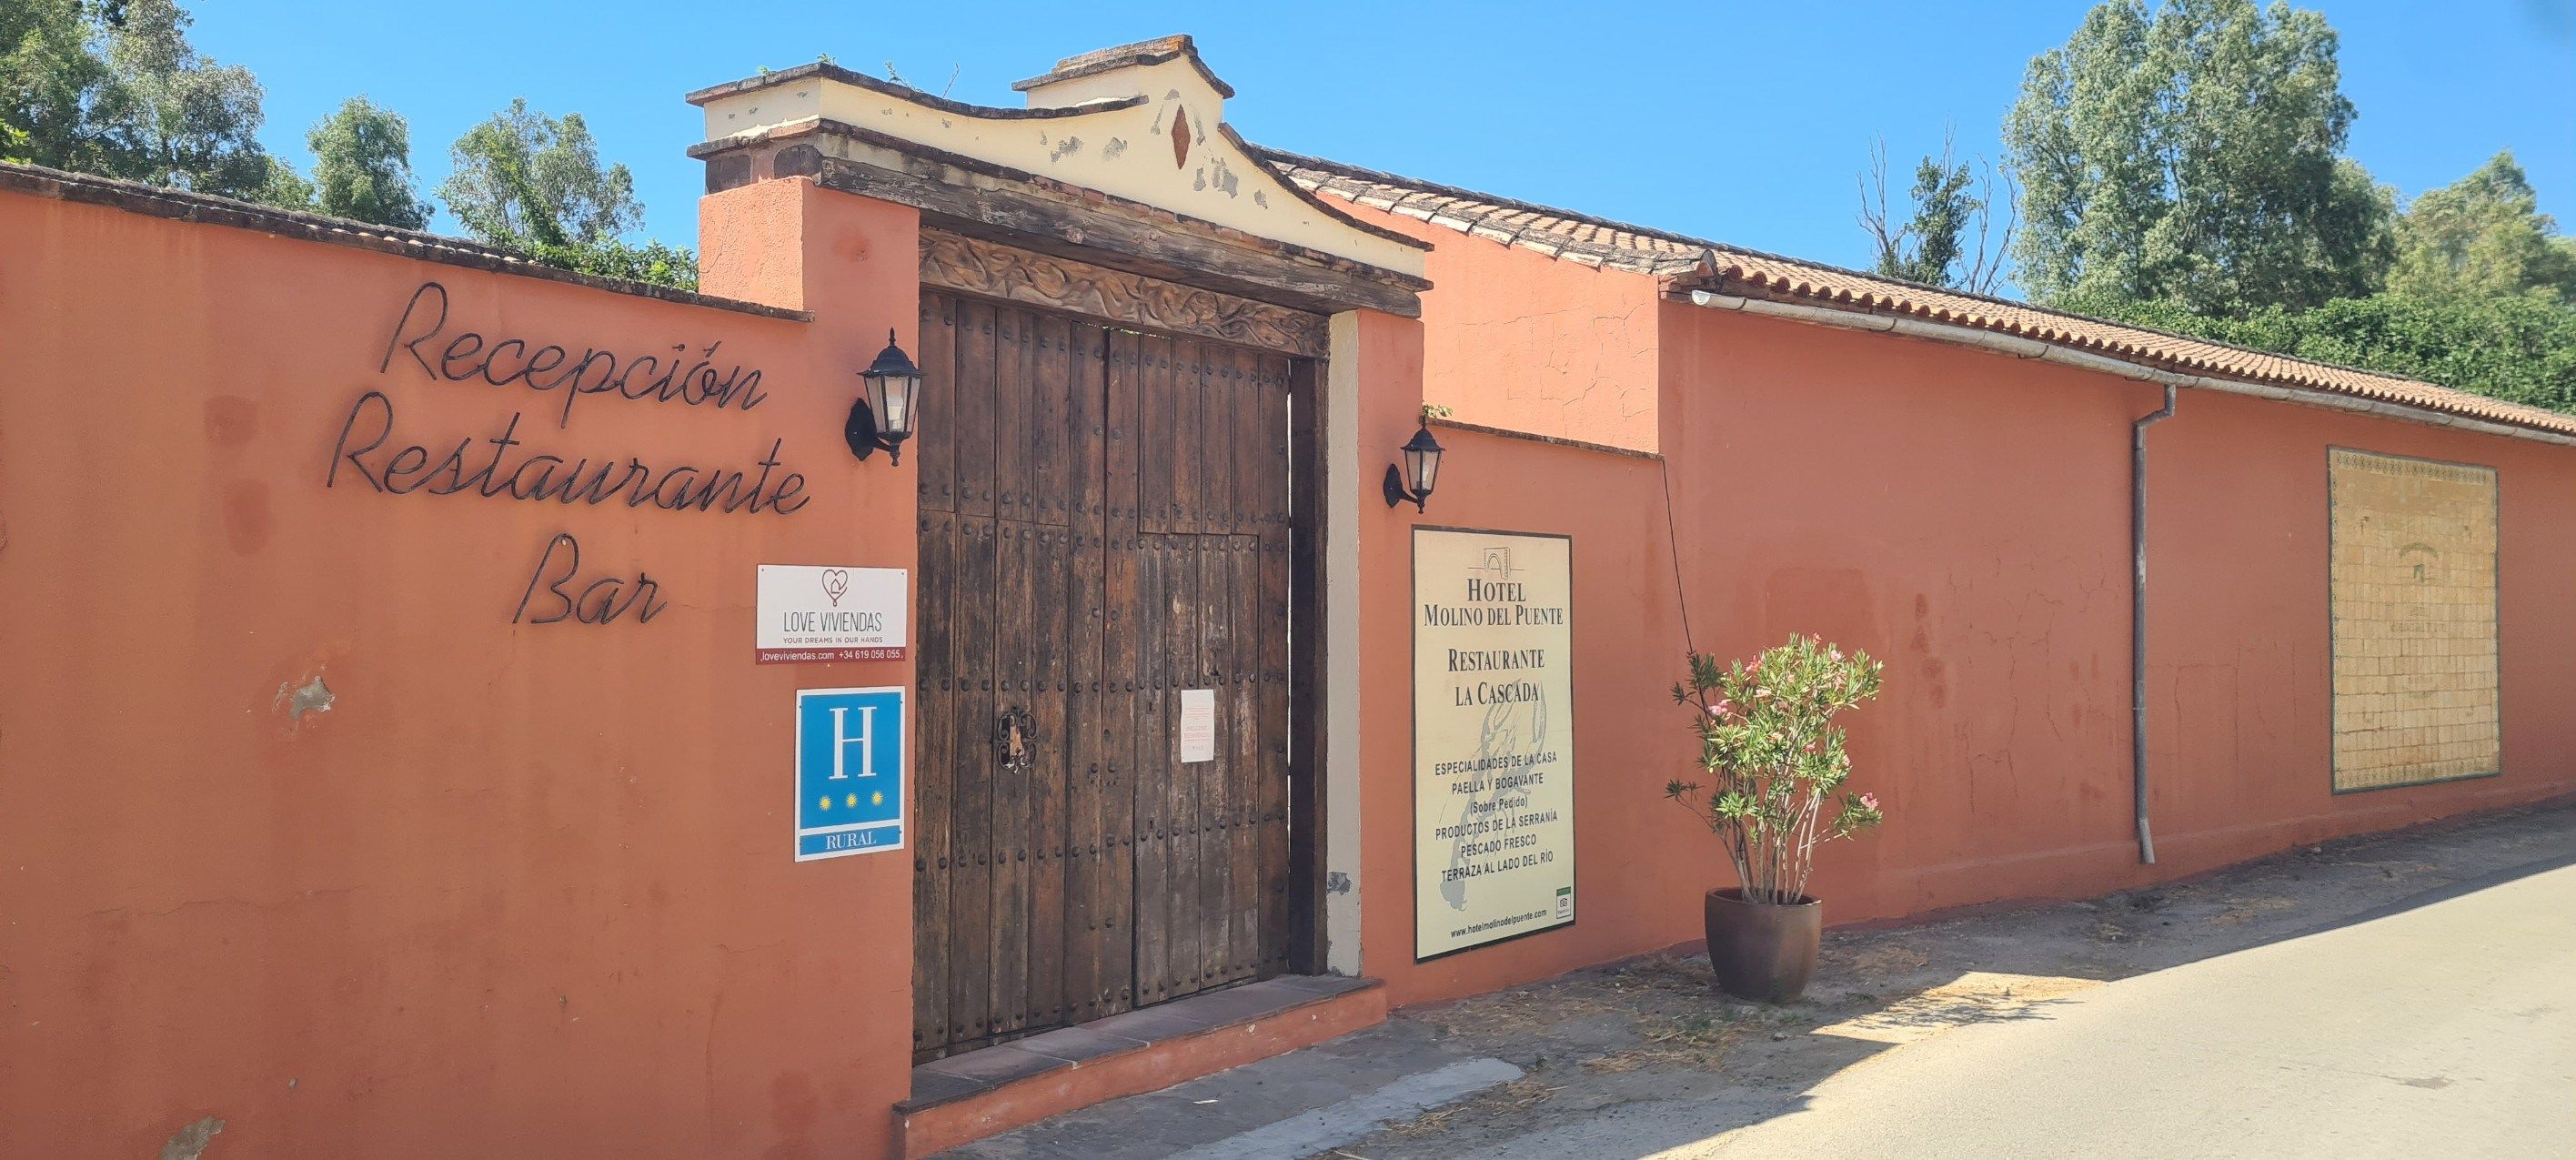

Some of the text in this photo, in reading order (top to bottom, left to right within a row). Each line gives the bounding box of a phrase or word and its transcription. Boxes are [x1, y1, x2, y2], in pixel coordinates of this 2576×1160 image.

[380, 281, 768, 429] Recepción
[327, 391, 810, 515] Restaurante
[512, 532, 668, 625] Bar
[1466, 578, 1526, 602] HOTEL
[783, 611, 882, 632] LOVE VIVIENDAS
[1424, 604, 1564, 627] MOLINO DEL PUENTE
[839, 650, 853, 660] +34
[854, 650, 870, 659] 619
[870, 649, 885, 659] 056
[886, 649, 901, 659] 055
[1447, 648, 1545, 672] RESTAURANTE
[1455, 681, 1539, 706] LA CASCADA
[829, 706, 877, 780] H
[1434, 751, 1557, 776] ESPECIALIDADES DE LA CASA
[1452, 772, 1544, 795] PAELLA Y BOGAVANTE
[1470, 794, 1528, 815] (Sobre Pedido)
[1435, 808, 1558, 841] PRODUCTOS DE LA SERRANÍA
[825, 831, 877, 850] RURAL
[1461, 833, 1537, 858] PESCADO FRESCO
[1442, 848, 1554, 883] TERRAZA AL LADO DEL RÍO
[1451, 909, 1547, 938] www.hotelmolinodelpuente.com
